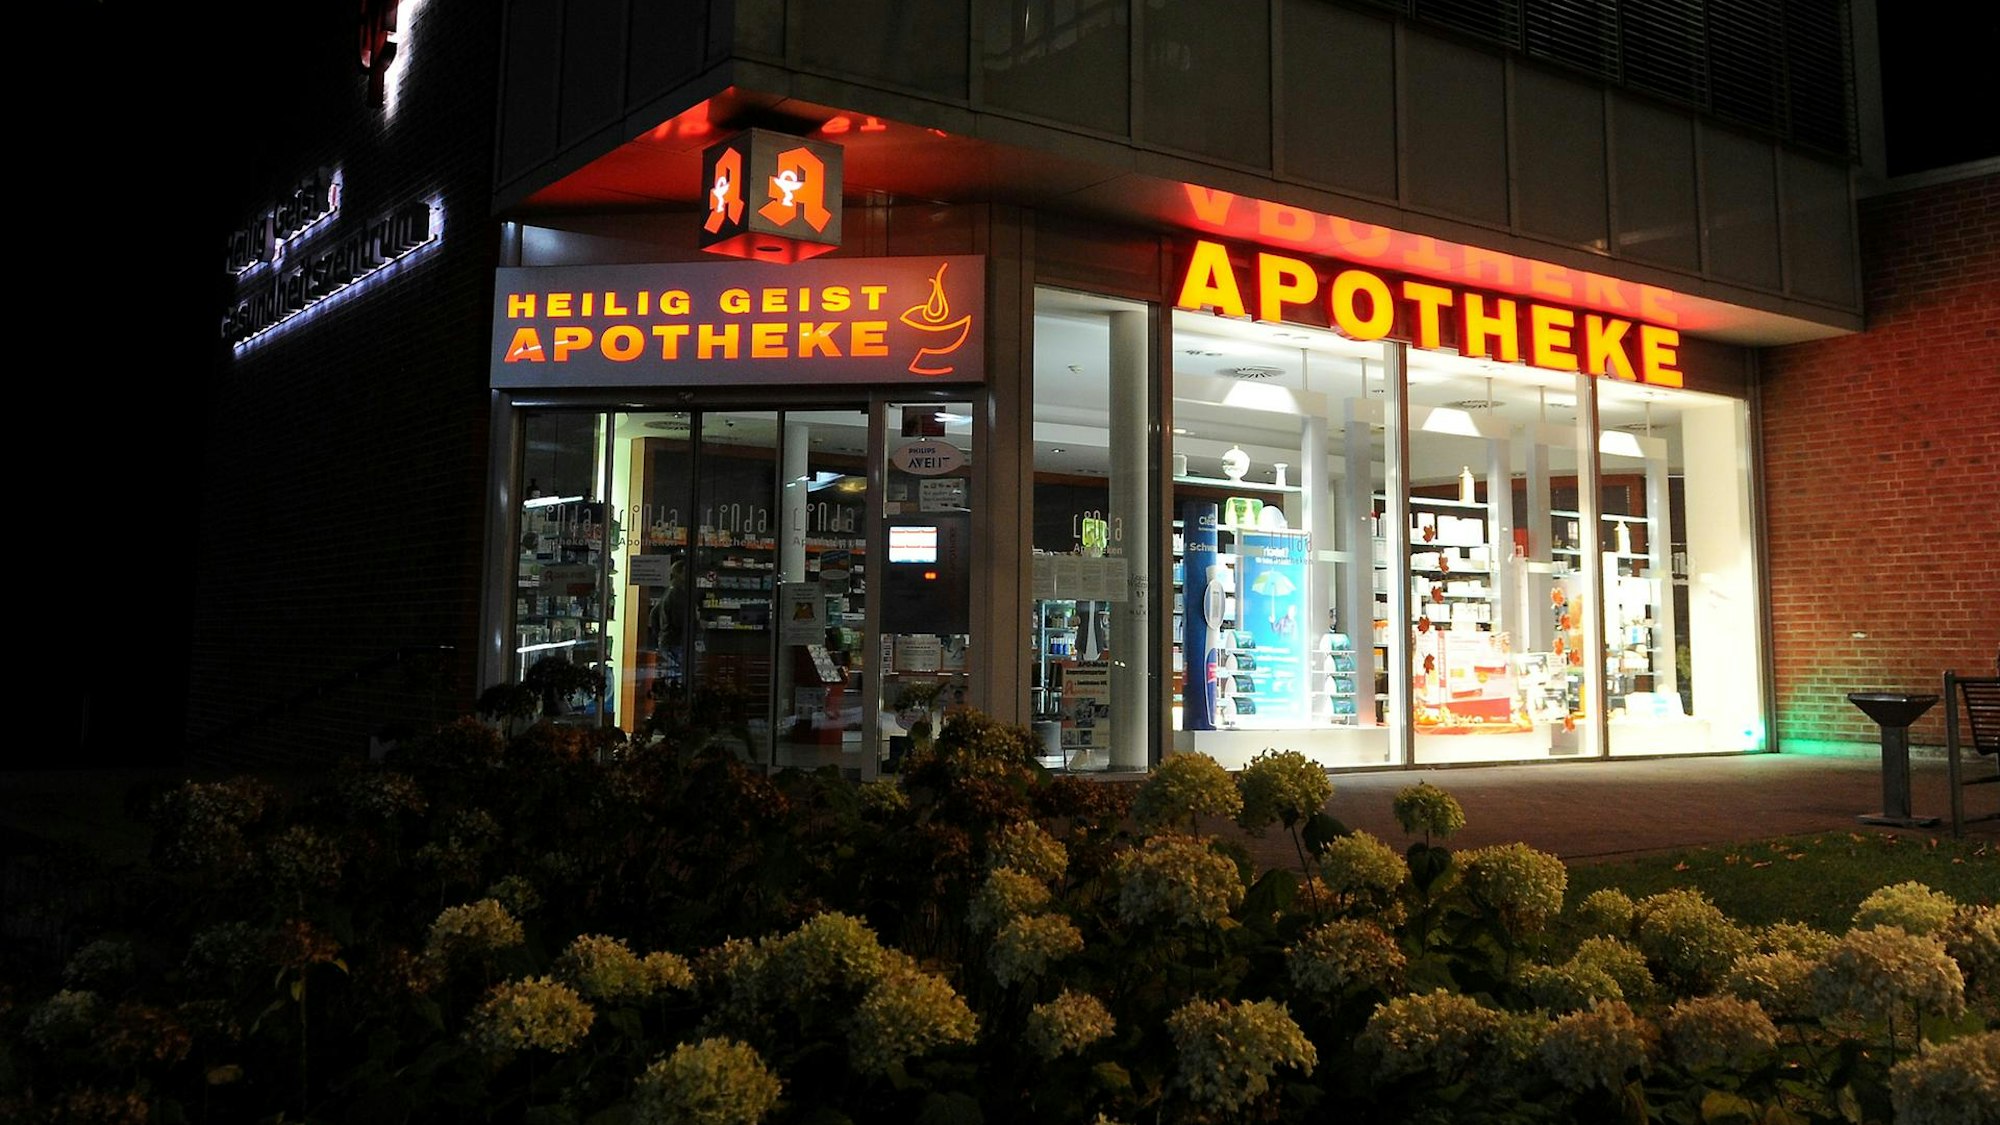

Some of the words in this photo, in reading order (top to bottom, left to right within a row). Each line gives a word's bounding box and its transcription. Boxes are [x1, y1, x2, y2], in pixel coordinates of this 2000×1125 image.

[758, 147, 832, 234] A
[507, 289, 690, 318] HEILIG
[719, 286, 888, 315] GEIST
[1177, 240, 1684, 388] APOTHEKE
[504, 321, 889, 361] APOTHEKE
[908, 447, 936, 455] PHILIPS
